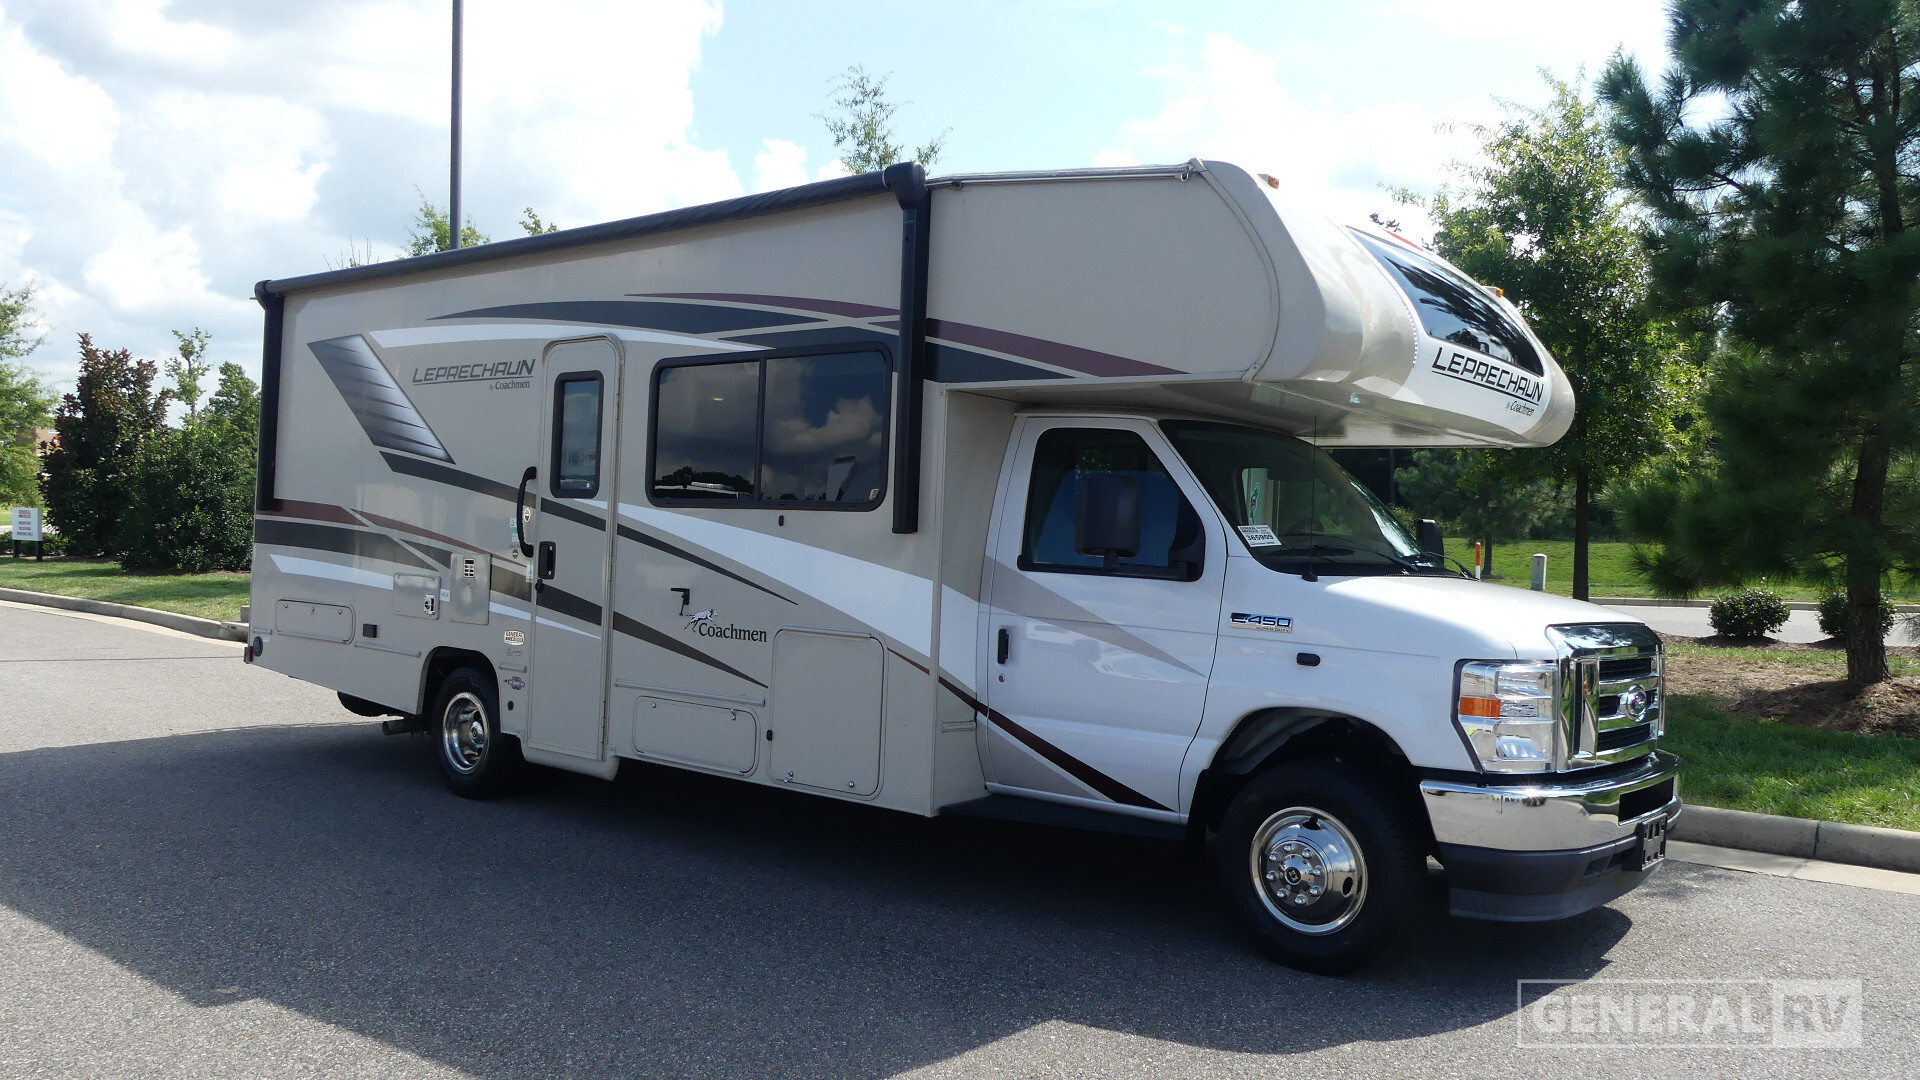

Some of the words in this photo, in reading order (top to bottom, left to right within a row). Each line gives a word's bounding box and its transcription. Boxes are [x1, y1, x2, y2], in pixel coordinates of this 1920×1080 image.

[412, 359, 536, 383] LEPRECHAUN
[1431, 347, 1544, 402] LEPRECHAUN
[495, 380, 530, 390] Coachmen
[1510, 400, 1535, 416] Coachmen
[698, 622, 767, 642] Coachmen
